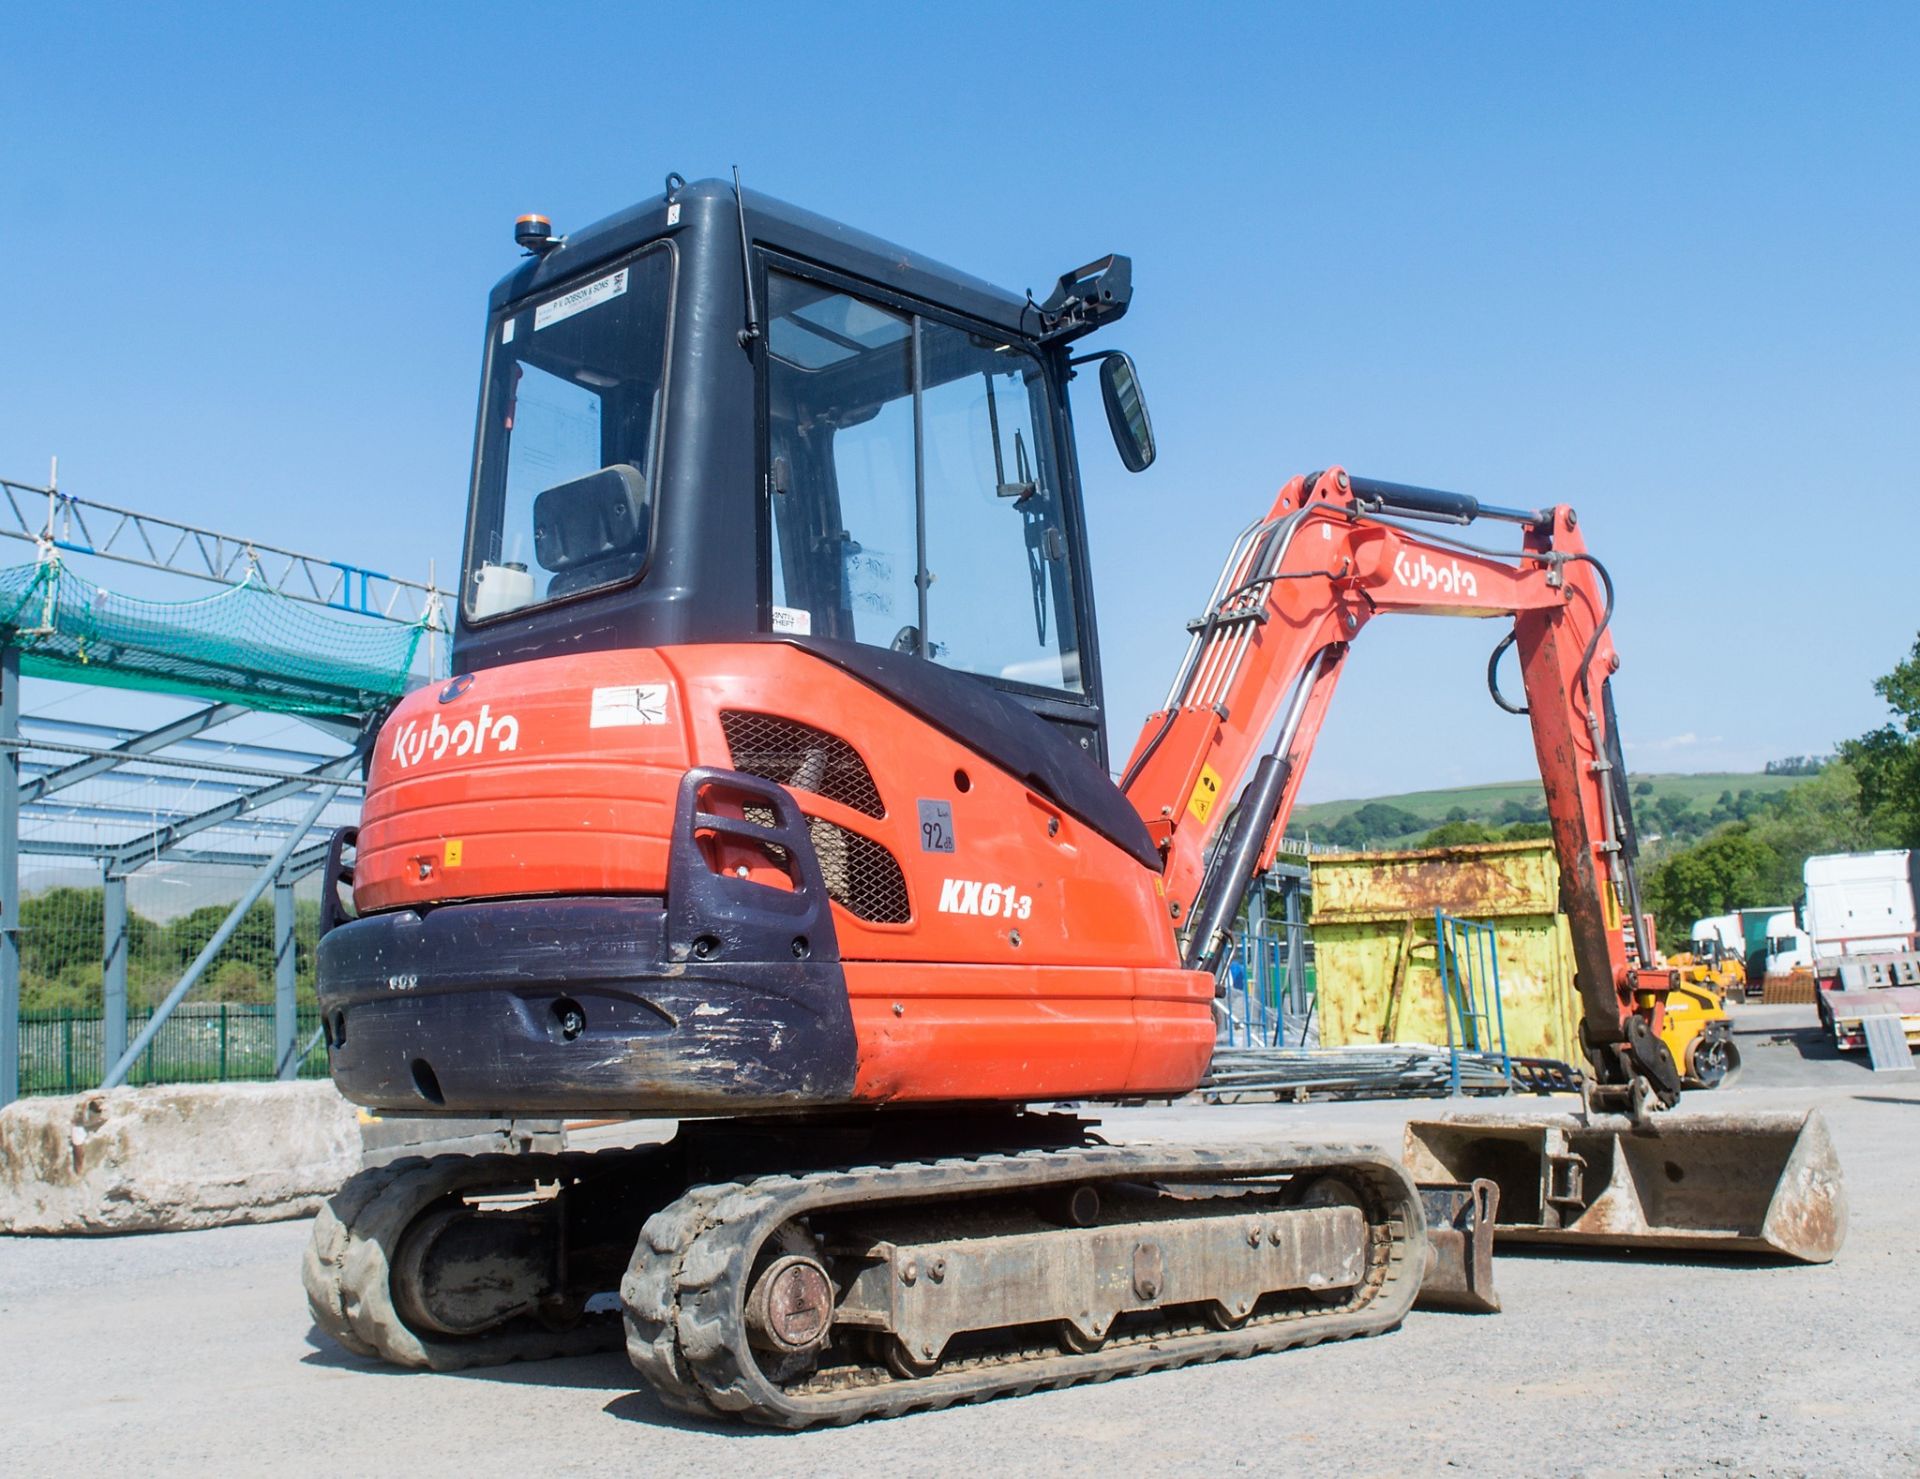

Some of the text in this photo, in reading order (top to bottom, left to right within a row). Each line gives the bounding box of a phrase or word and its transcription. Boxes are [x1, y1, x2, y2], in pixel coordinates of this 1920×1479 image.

[593, 279, 609, 293] SONS
[1393, 551, 1478, 598] Kubota
[391, 704, 519, 768] Kubota
[922, 822, 943, 849] 92
